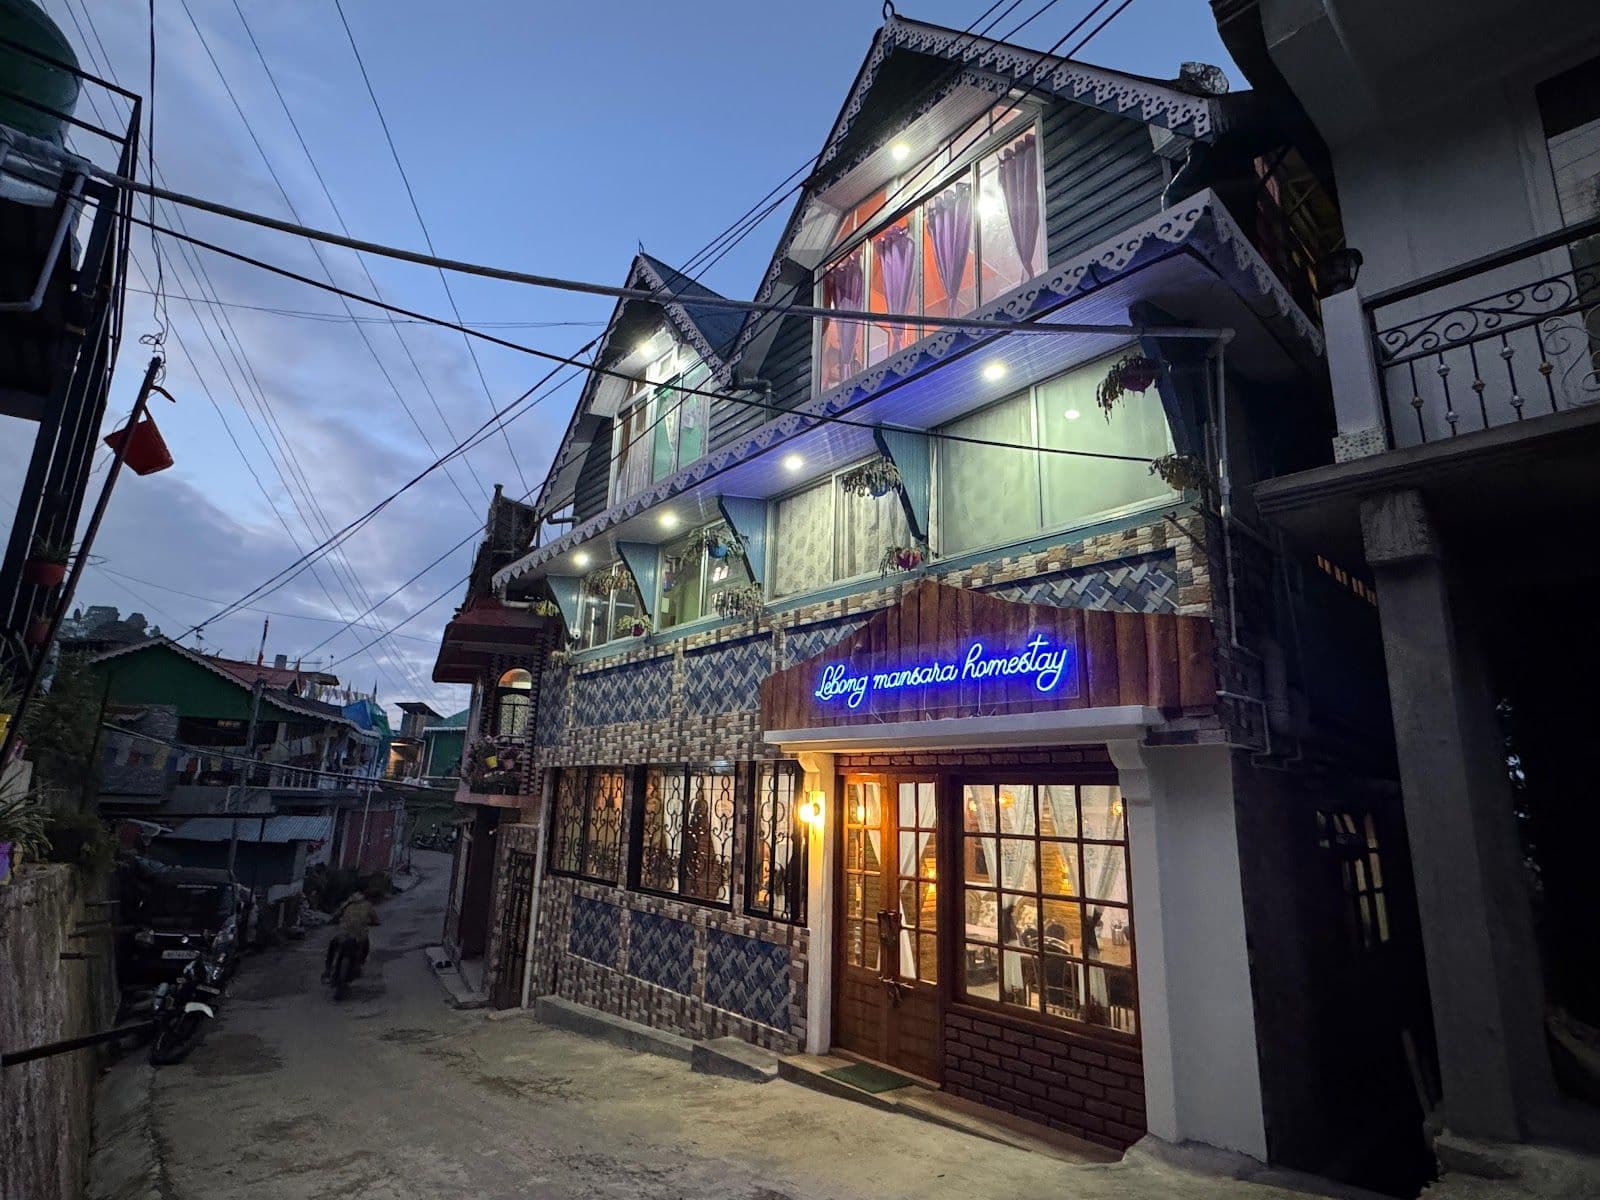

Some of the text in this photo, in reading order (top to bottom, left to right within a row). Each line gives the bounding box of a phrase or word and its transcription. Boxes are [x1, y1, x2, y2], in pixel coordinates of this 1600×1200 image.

[815, 634, 1067, 708] Lebong mansara homestay
